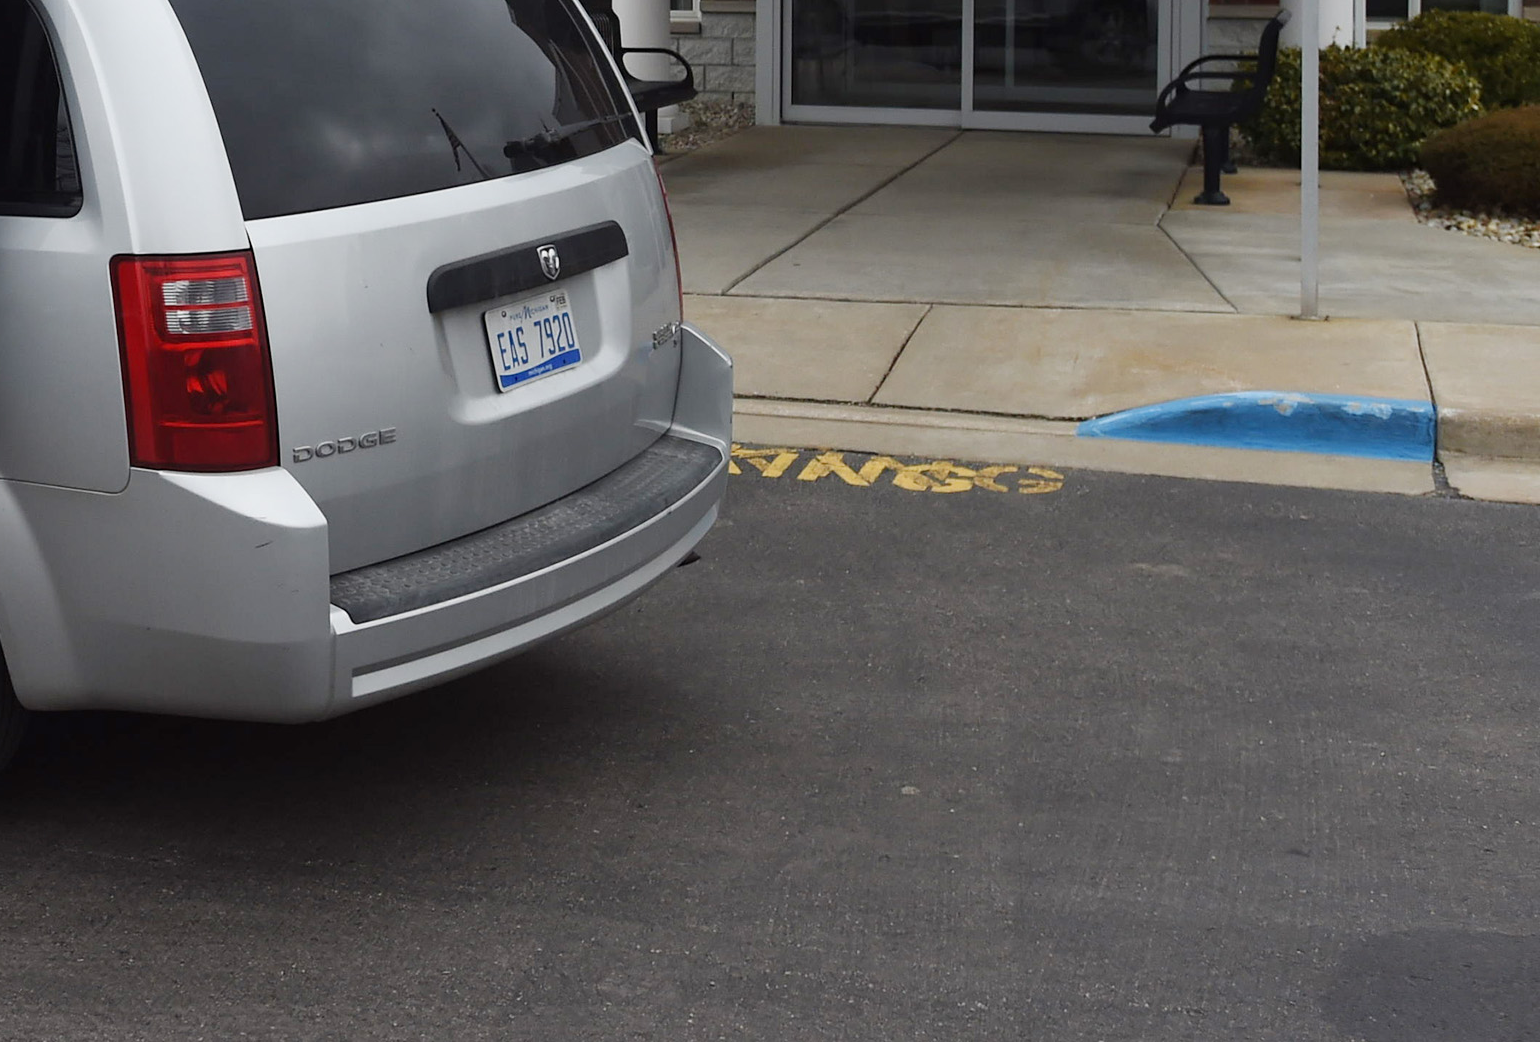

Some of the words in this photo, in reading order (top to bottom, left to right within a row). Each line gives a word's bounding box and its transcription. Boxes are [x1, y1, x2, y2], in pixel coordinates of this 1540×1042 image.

[497, 326, 529, 371] EAS
[533, 312, 575, 358] 7920
[292, 427, 397, 463] DODGE
